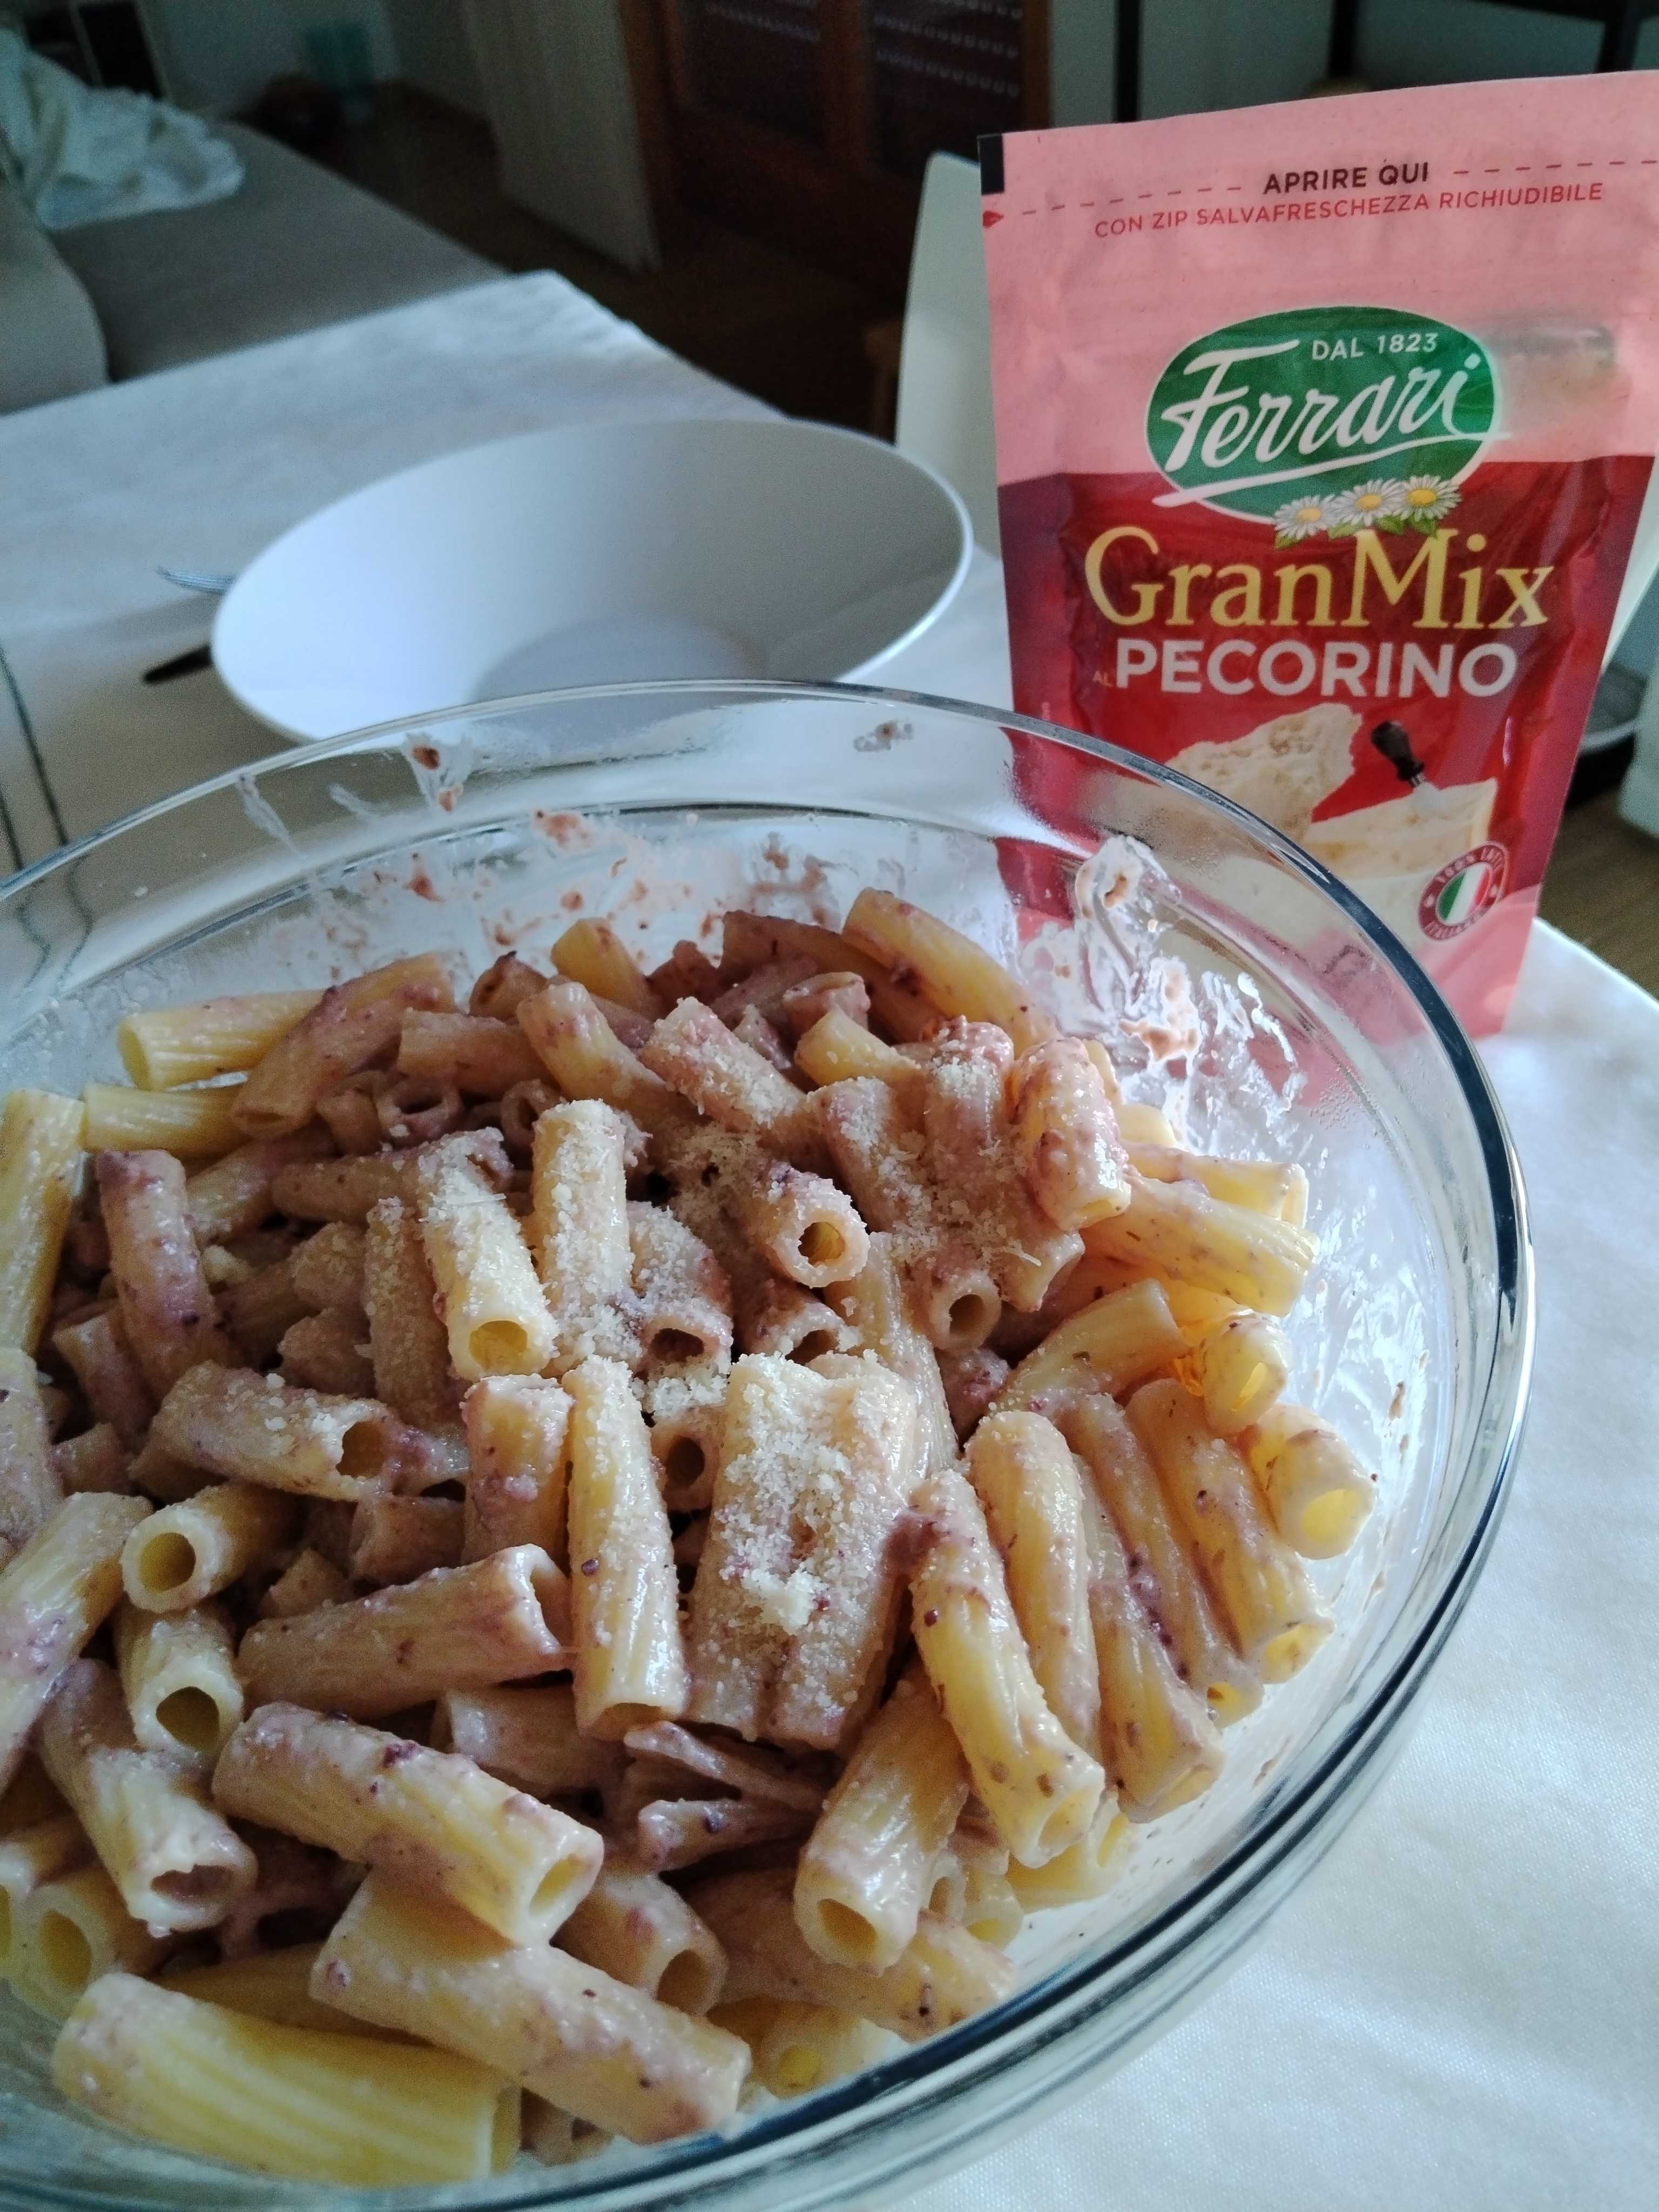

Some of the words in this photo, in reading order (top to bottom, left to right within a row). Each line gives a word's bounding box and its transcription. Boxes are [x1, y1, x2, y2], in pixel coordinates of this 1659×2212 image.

[1262, 167, 1368, 195] APRIRE
[1378, 161, 1428, 186] QUI
[1094, 215, 1143, 238] CON
[1151, 210, 1188, 230] ZIP
[1196, 192, 1429, 226] SALVAFRESCHEZZA
[1439, 182, 1603, 210] RICHIUDIBILE
[1312, 338, 1364, 361] DAL
[1377, 333, 1439, 354] 1823
[1159, 339, 1483, 473] Ferrari
[1116, 638, 1518, 698] PECORINO
